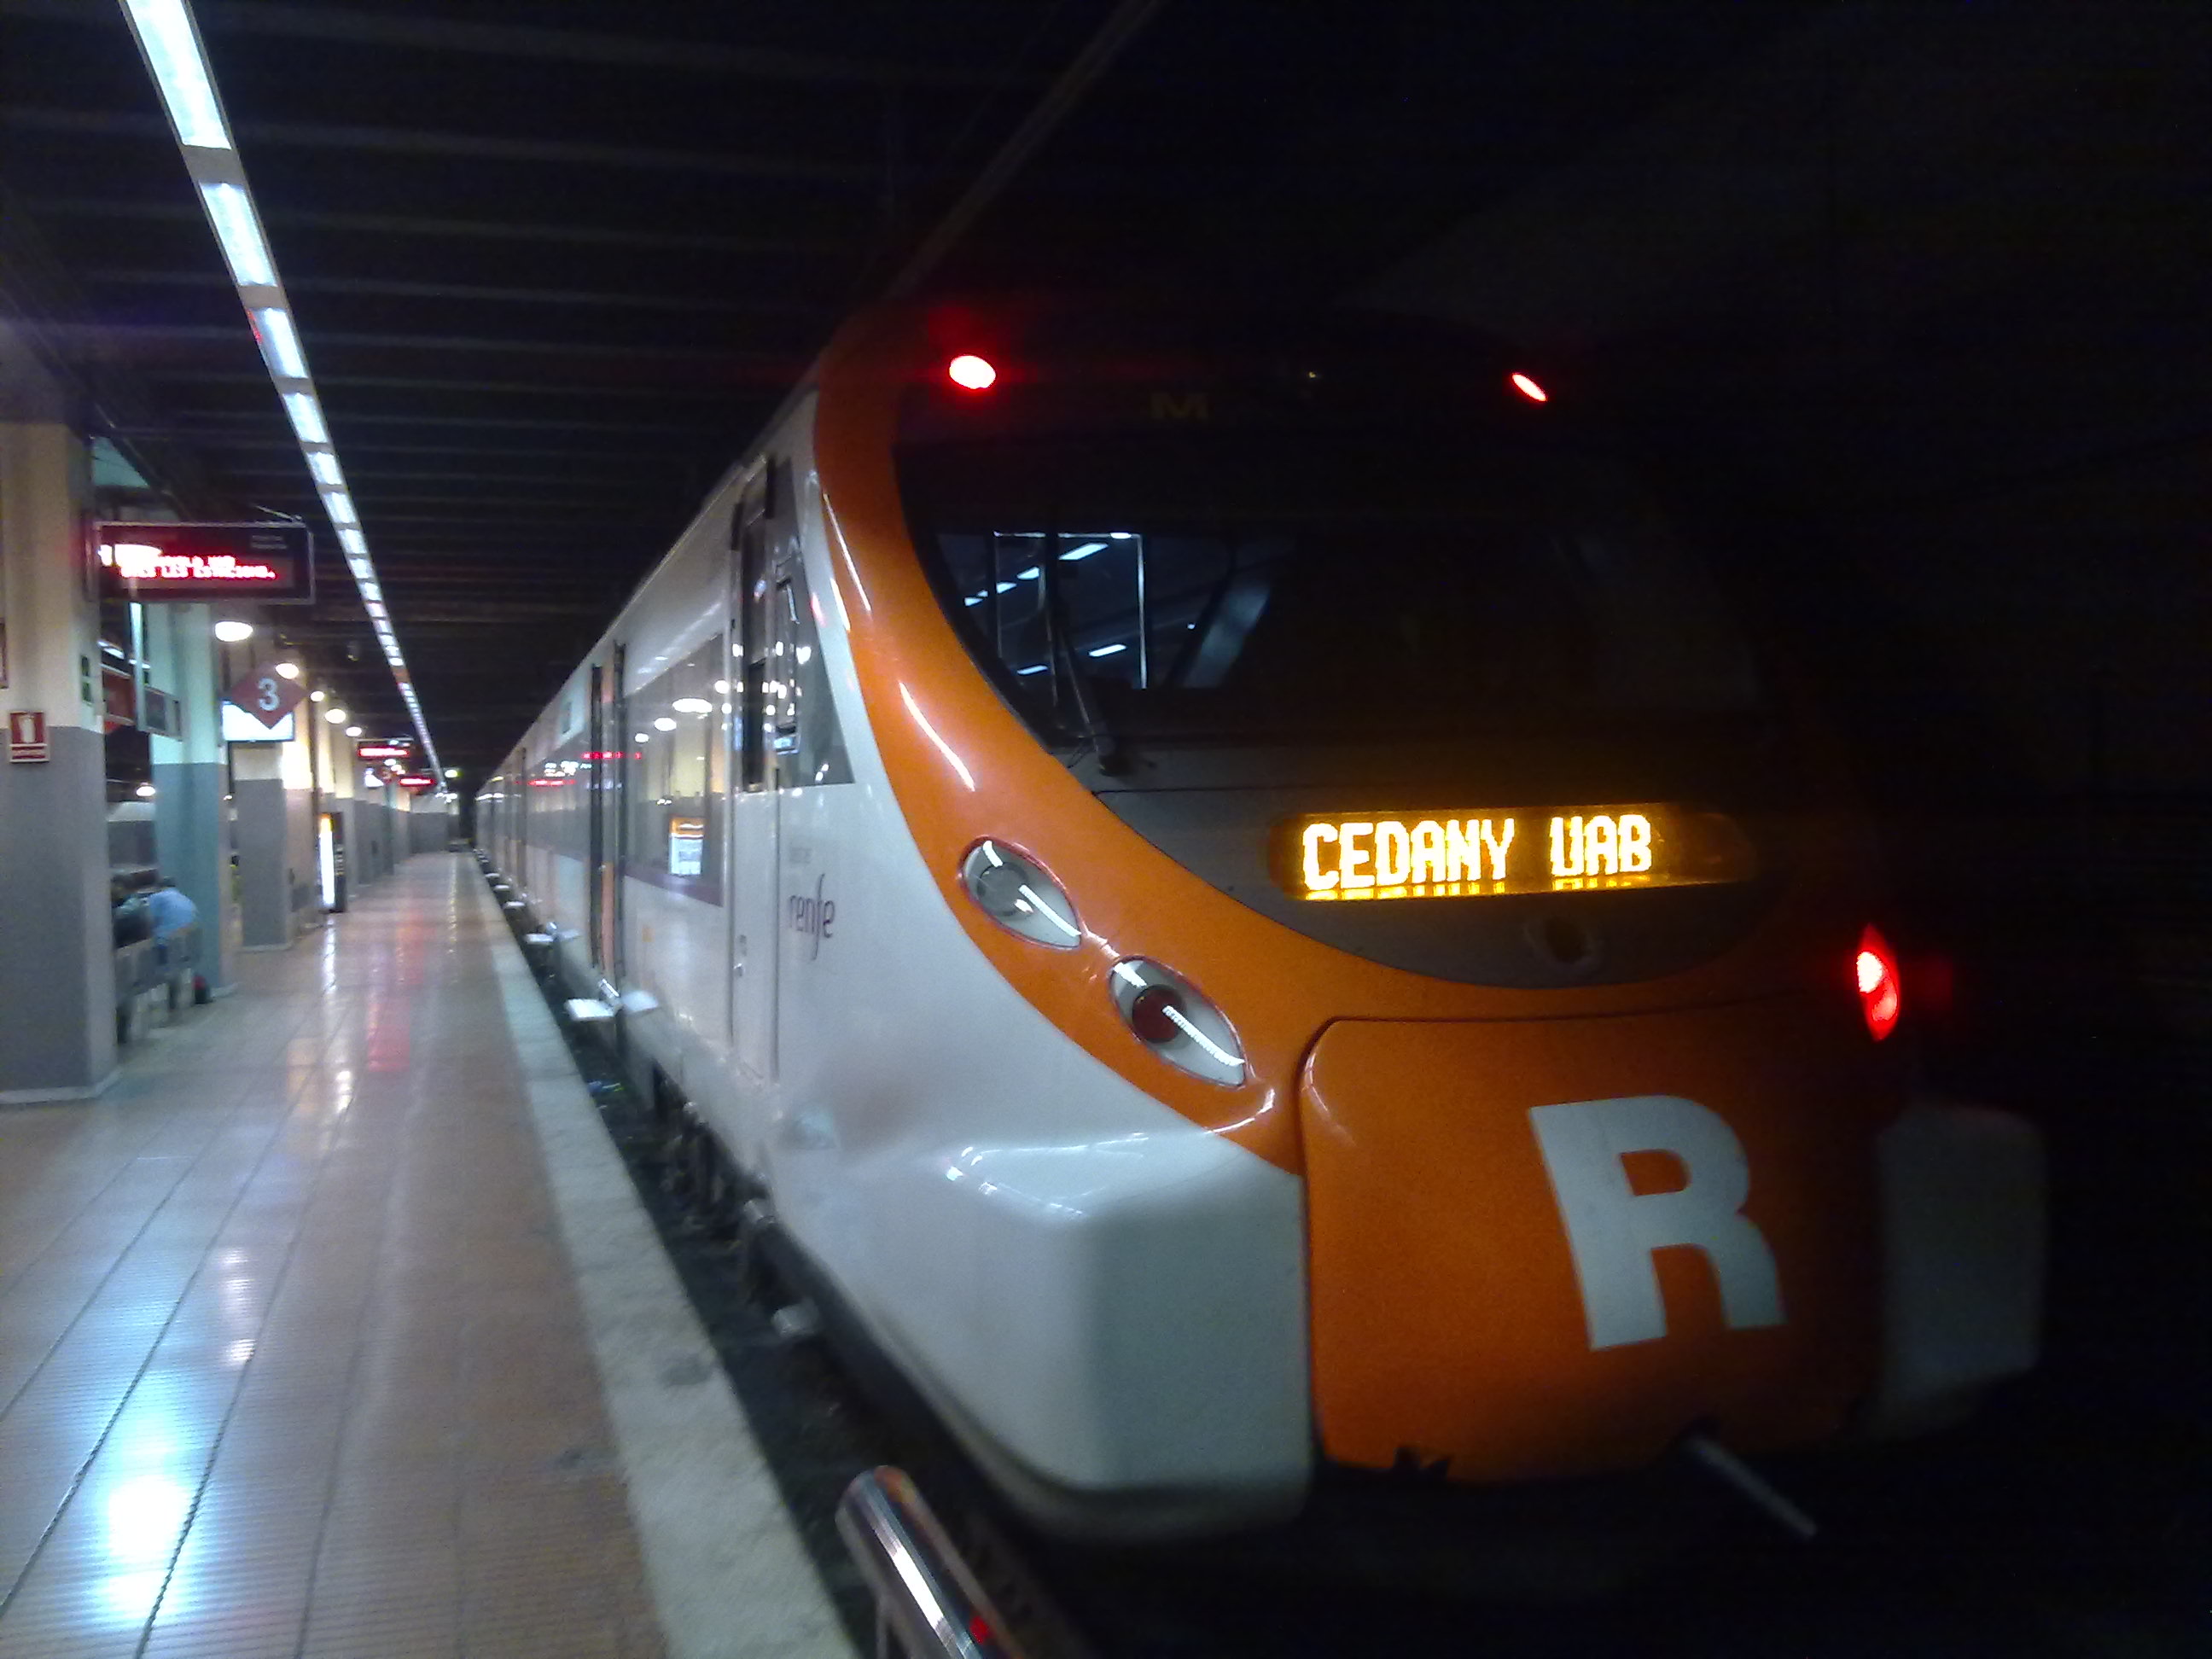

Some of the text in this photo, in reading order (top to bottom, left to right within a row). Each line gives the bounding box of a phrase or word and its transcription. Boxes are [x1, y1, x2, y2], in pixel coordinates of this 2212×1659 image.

[259, 678, 280, 711] 3
[1302, 814, 1652, 890] CEDANY UAB
[789, 873, 835, 960] renfe
[1528, 1094, 1787, 1351] R
